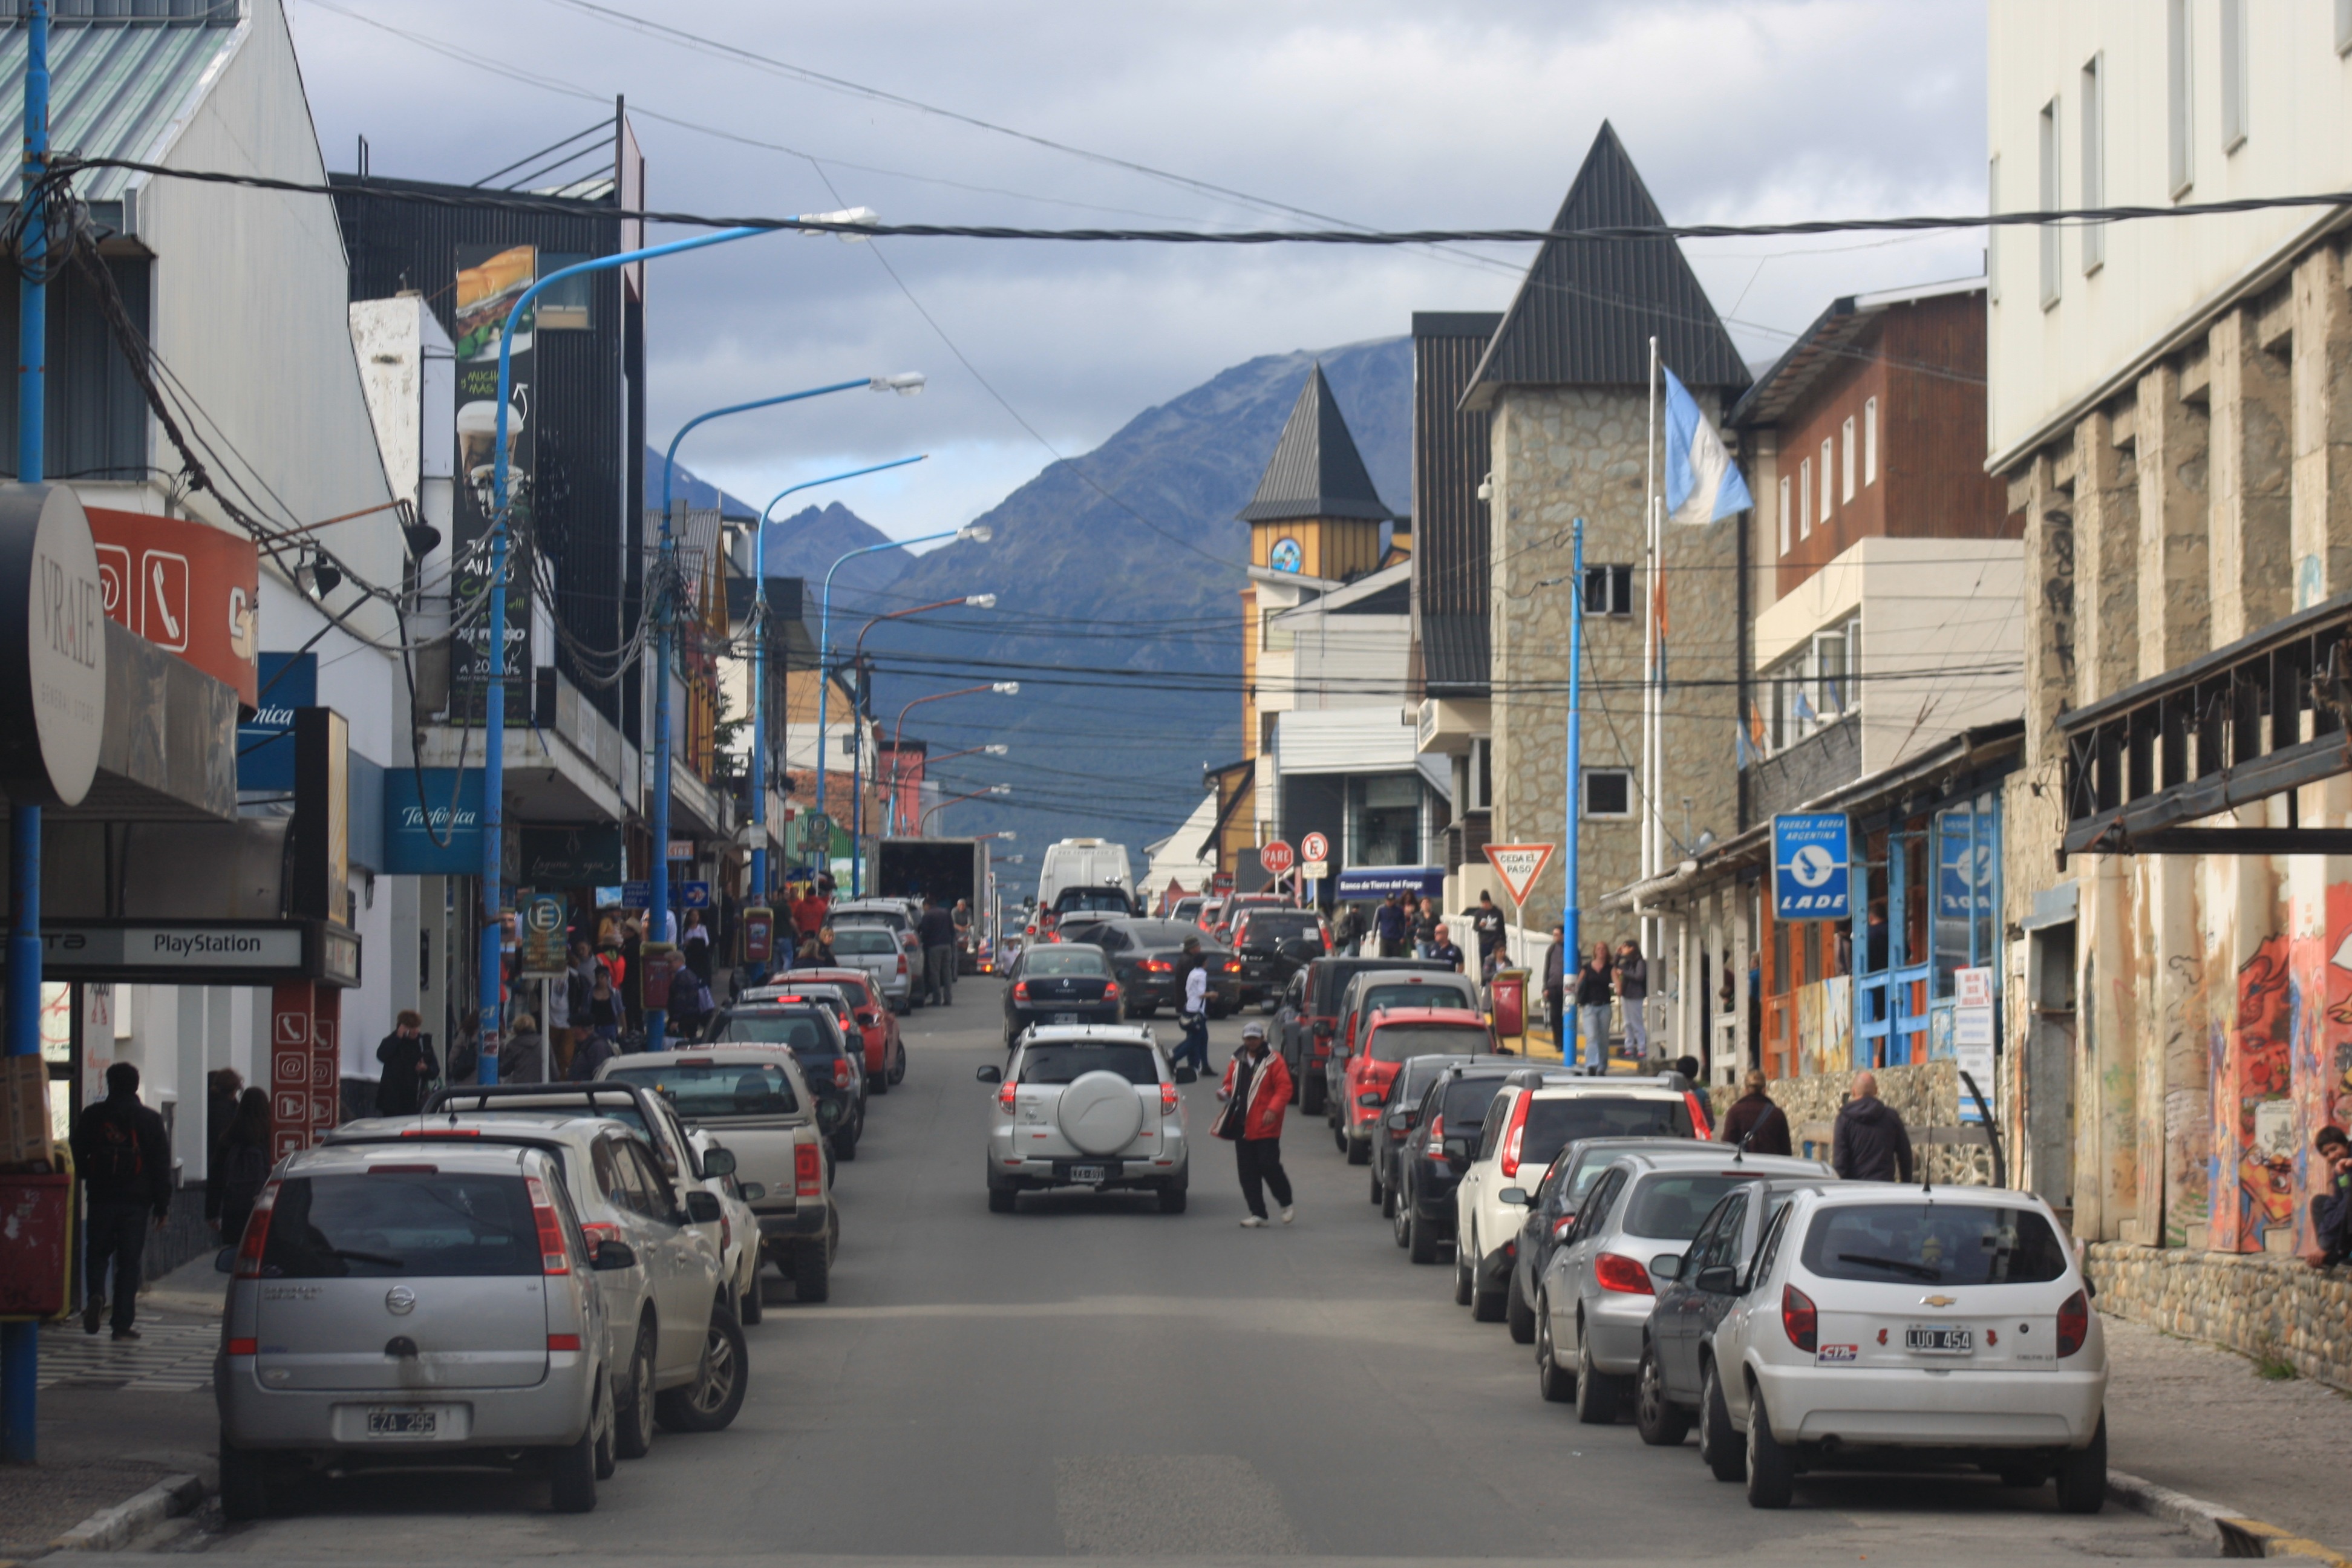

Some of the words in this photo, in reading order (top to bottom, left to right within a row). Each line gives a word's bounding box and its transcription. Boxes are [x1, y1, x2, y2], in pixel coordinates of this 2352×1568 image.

[468, 370, 498, 383] MUCH
[40, 553, 96, 668] VRAIE
[1779, 820, 1811, 829] FUERZA
[1786, 831, 1837, 840] ARGENTINA
[1264, 850, 1289, 863] PARE
[1340, 881, 1361, 890] Banco
[1362, 881, 1370, 890] de
[1371, 881, 1390, 889] Tierra
[1391, 880, 1401, 889] del
[1402, 880, 1423, 890] Fuego
[1780, 894, 1846, 909] LADE
[154, 934, 261, 956] PlayStation
[1943, 1331, 1969, 1348] 454
[370, 1414, 397, 1431] EZA
[407, 1414, 434, 1431] 295
